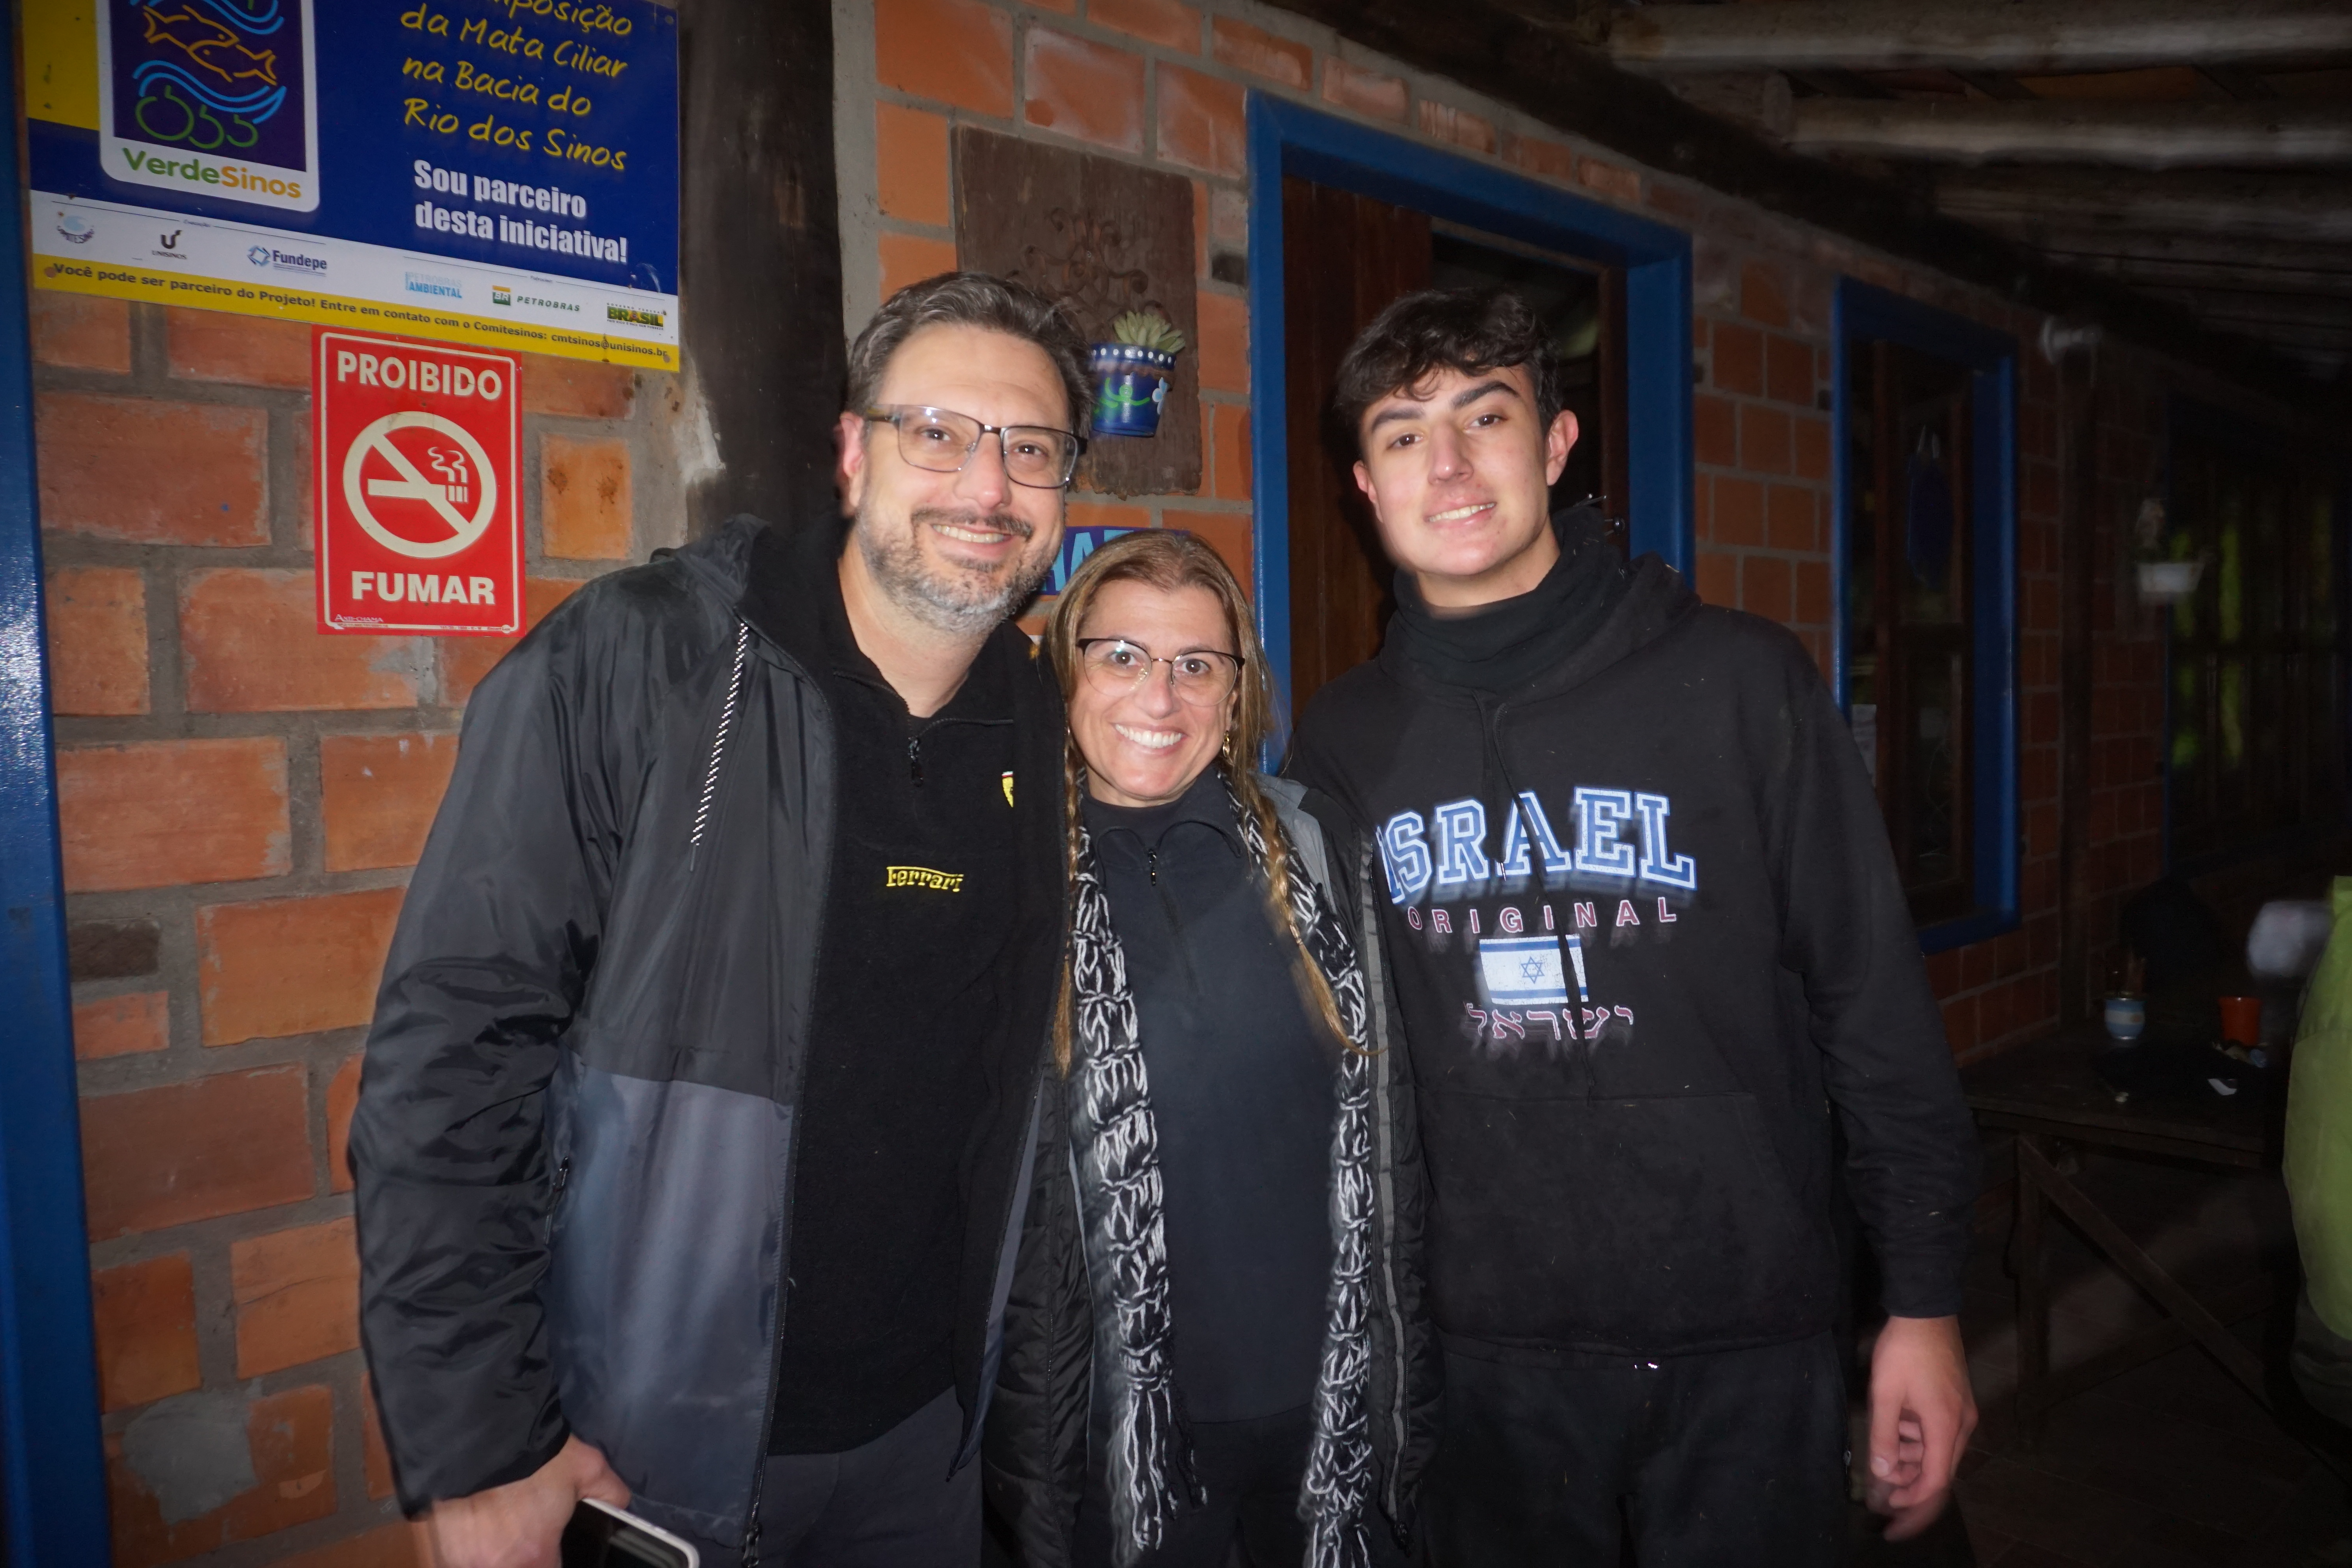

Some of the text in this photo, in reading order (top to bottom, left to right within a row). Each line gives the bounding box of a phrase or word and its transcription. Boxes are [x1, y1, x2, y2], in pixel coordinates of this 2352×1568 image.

[495, 0, 632, 35] posição
[400, 2, 628, 77] da Mata Ciliar
[402, 57, 592, 115] na Bacia do
[404, 98, 627, 171] Rio dos Sinos
[122, 147, 301, 198] VerdeSinos
[414, 159, 587, 218] Sou parceiro
[415, 201, 627, 263] desta iniciativa!
[152, 250, 187, 260] UNISINOS
[272, 250, 327, 270] Fundepe
[408, 272, 461, 287] PETROBRAS
[409, 281, 462, 298] AMBIENTAL
[54, 263, 93, 278] Você
[98, 271, 136, 283] pode
[141, 276, 165, 287] ser
[170, 279, 232, 296] parceiro
[237, 288, 254, 299] do
[260, 290, 316, 306] Projeto!
[321, 299, 356, 312] Entre
[361, 307, 379, 316] em
[384, 310, 430, 323] contato
[434, 317, 459, 327] com
[474, 321, 547, 339] Comitesinos:
[551, 333, 668, 356] cmtsinos@unisinos.br
[494, 292, 580, 311] BR PETROBRAS
[607, 306, 663, 327] BRASIL
[337, 350, 502, 400] PROIBIDO
[351, 570, 495, 606] FUMAR
[886, 866, 964, 892] Ferrari
[1407, 896, 1677, 934] ORIGINAL
[1466, 1002, 1634, 1041] ישראל
